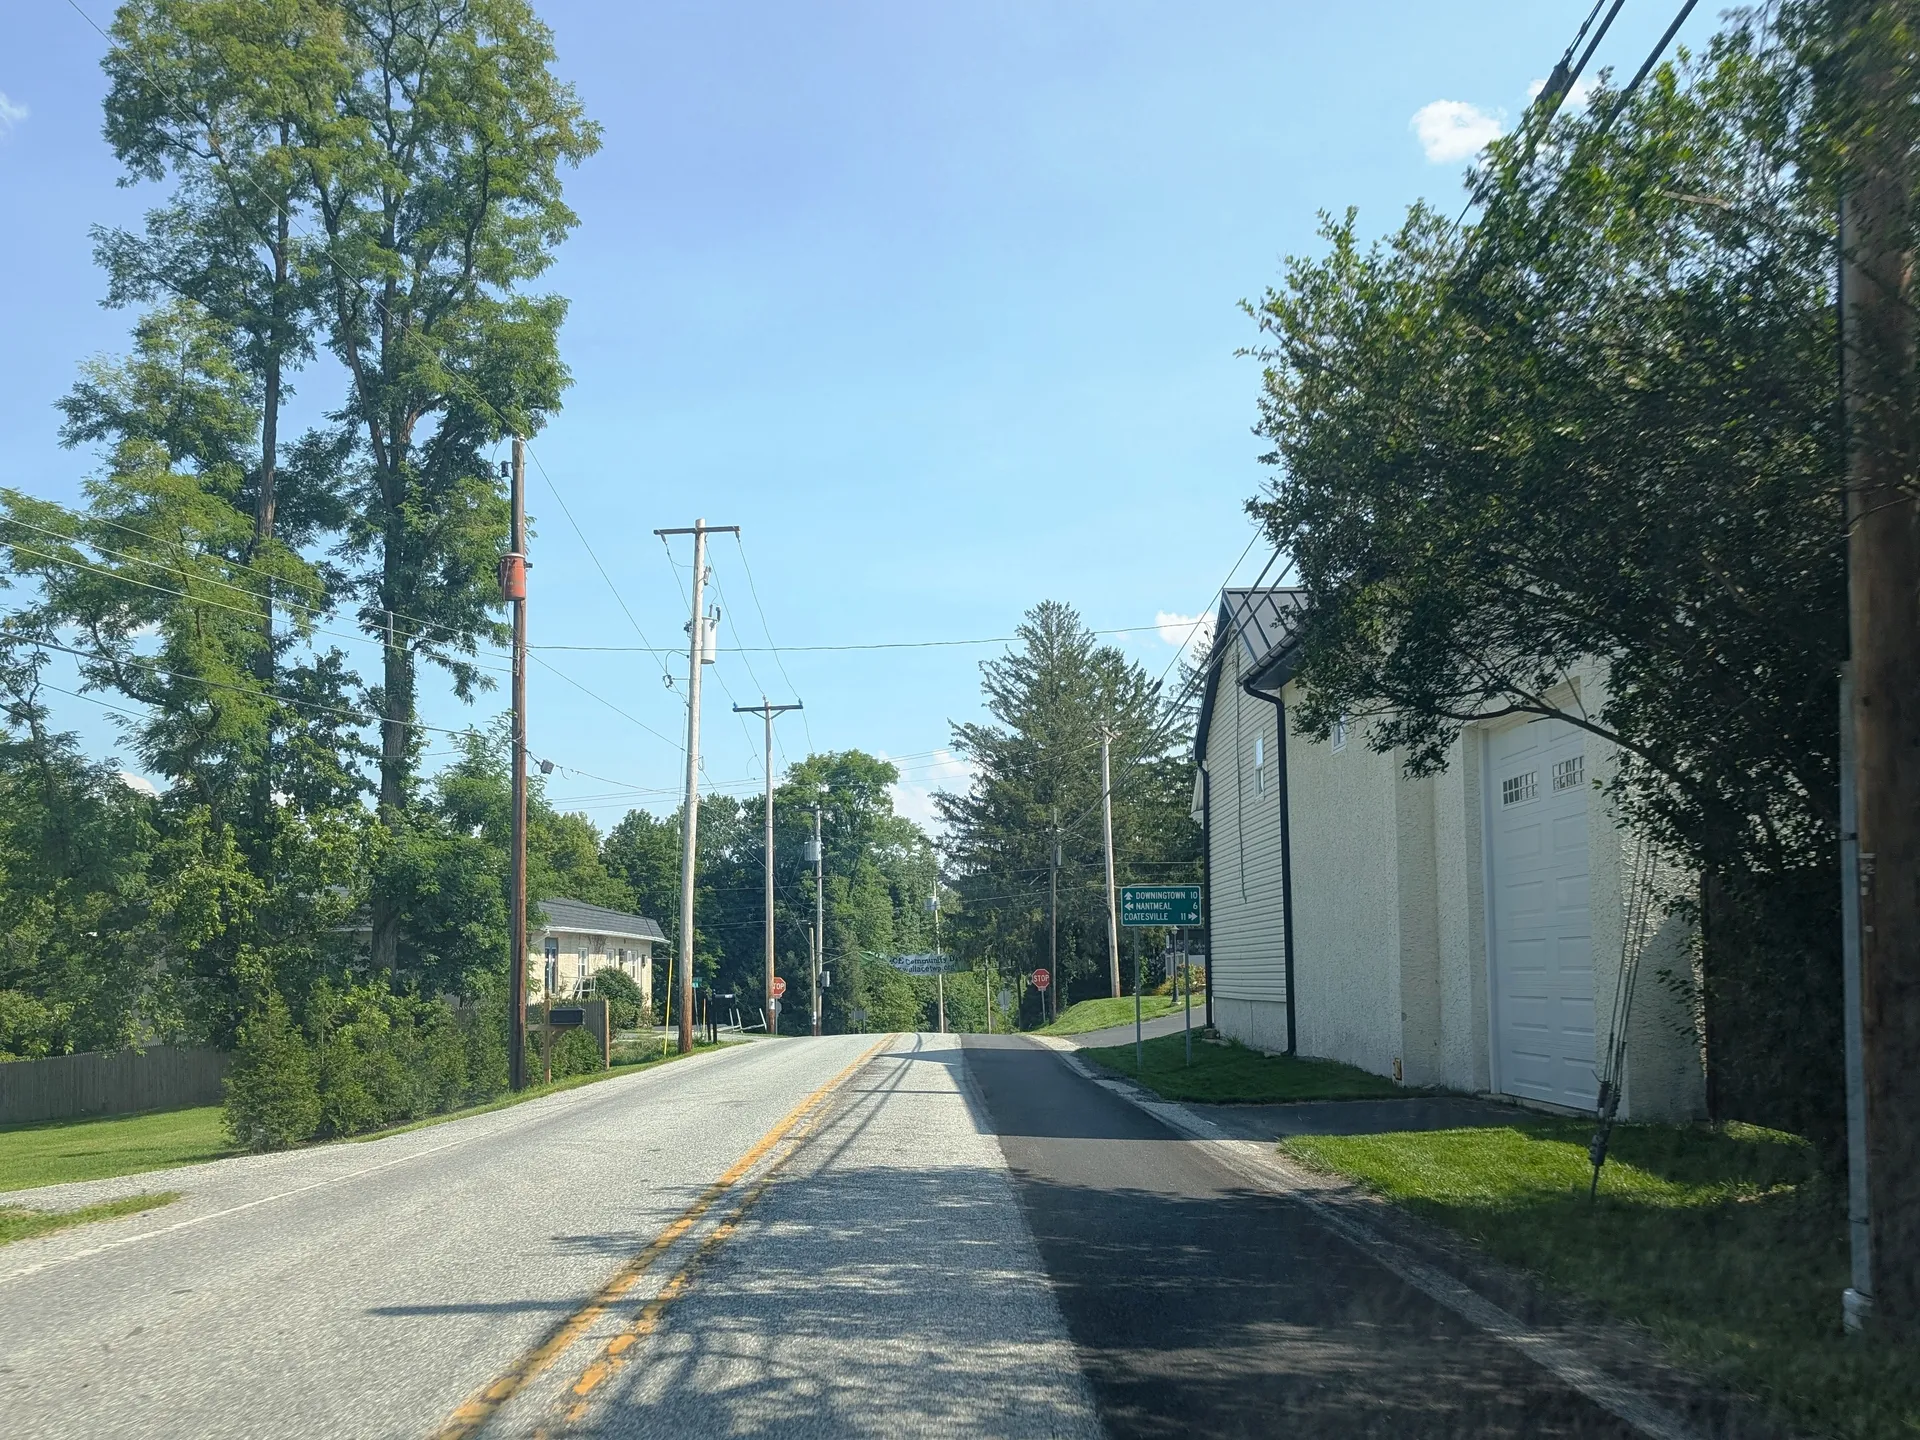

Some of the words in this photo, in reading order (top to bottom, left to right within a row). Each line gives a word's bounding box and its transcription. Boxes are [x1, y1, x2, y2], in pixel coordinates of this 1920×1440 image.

[1135, 891, 1186, 900] DOWNINGTOWN
[1190, 891, 1198, 900] 10
[1135, 902, 1172, 910] NANTMEAL
[1192, 902, 1198, 910] 6
[1123, 912, 1169, 921] COATESVILLE
[1180, 912, 1187, 921] 11
[905, 956, 947, 965] Community
[1033, 975, 1050, 983] STOP
[773, 982, 785, 990] TOP
